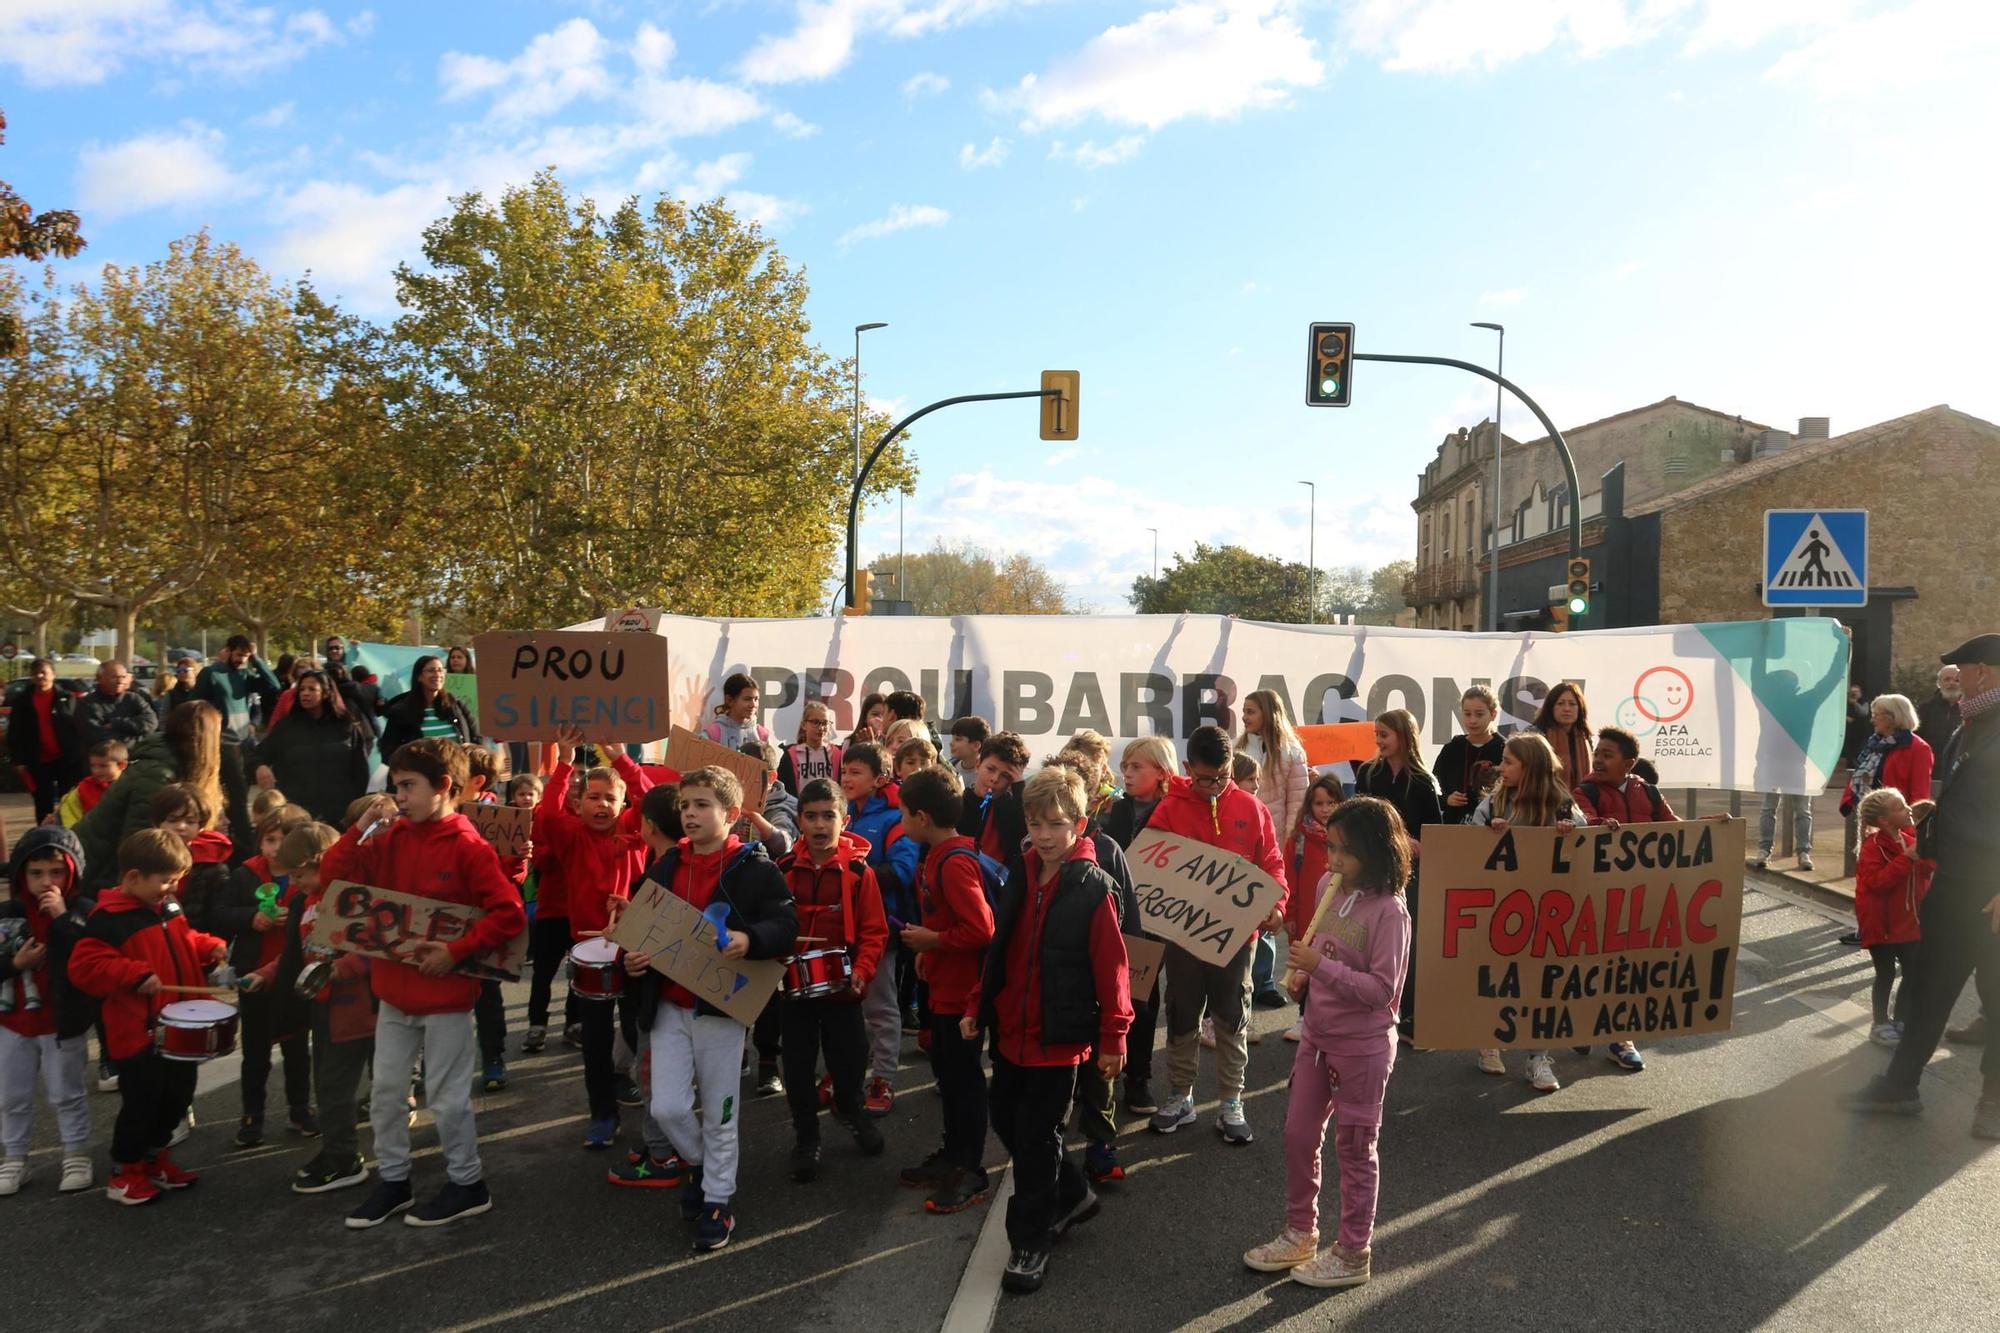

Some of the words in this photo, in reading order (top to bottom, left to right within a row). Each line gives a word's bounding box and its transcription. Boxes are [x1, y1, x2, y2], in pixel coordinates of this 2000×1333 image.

[512, 645, 624, 681] PROU
[495, 693, 655, 733] SILENCI
[1003, 670, 1586, 745] BARRACONS
[1655, 738, 1700, 747] ESCOLA
[1656, 725, 1688, 736] AFA
[1654, 748, 1712, 757] FORALLAC
[1484, 828, 1518, 872] A
[1552, 825, 1713, 874] L'ESCOLA
[1138, 840, 1181, 868] 16
[1175, 854, 1264, 908] ANYS
[1442, 879, 1722, 958] FORALLAC
[1477, 962, 1520, 998] LA
[1494, 1006, 1573, 1043] S'HA
